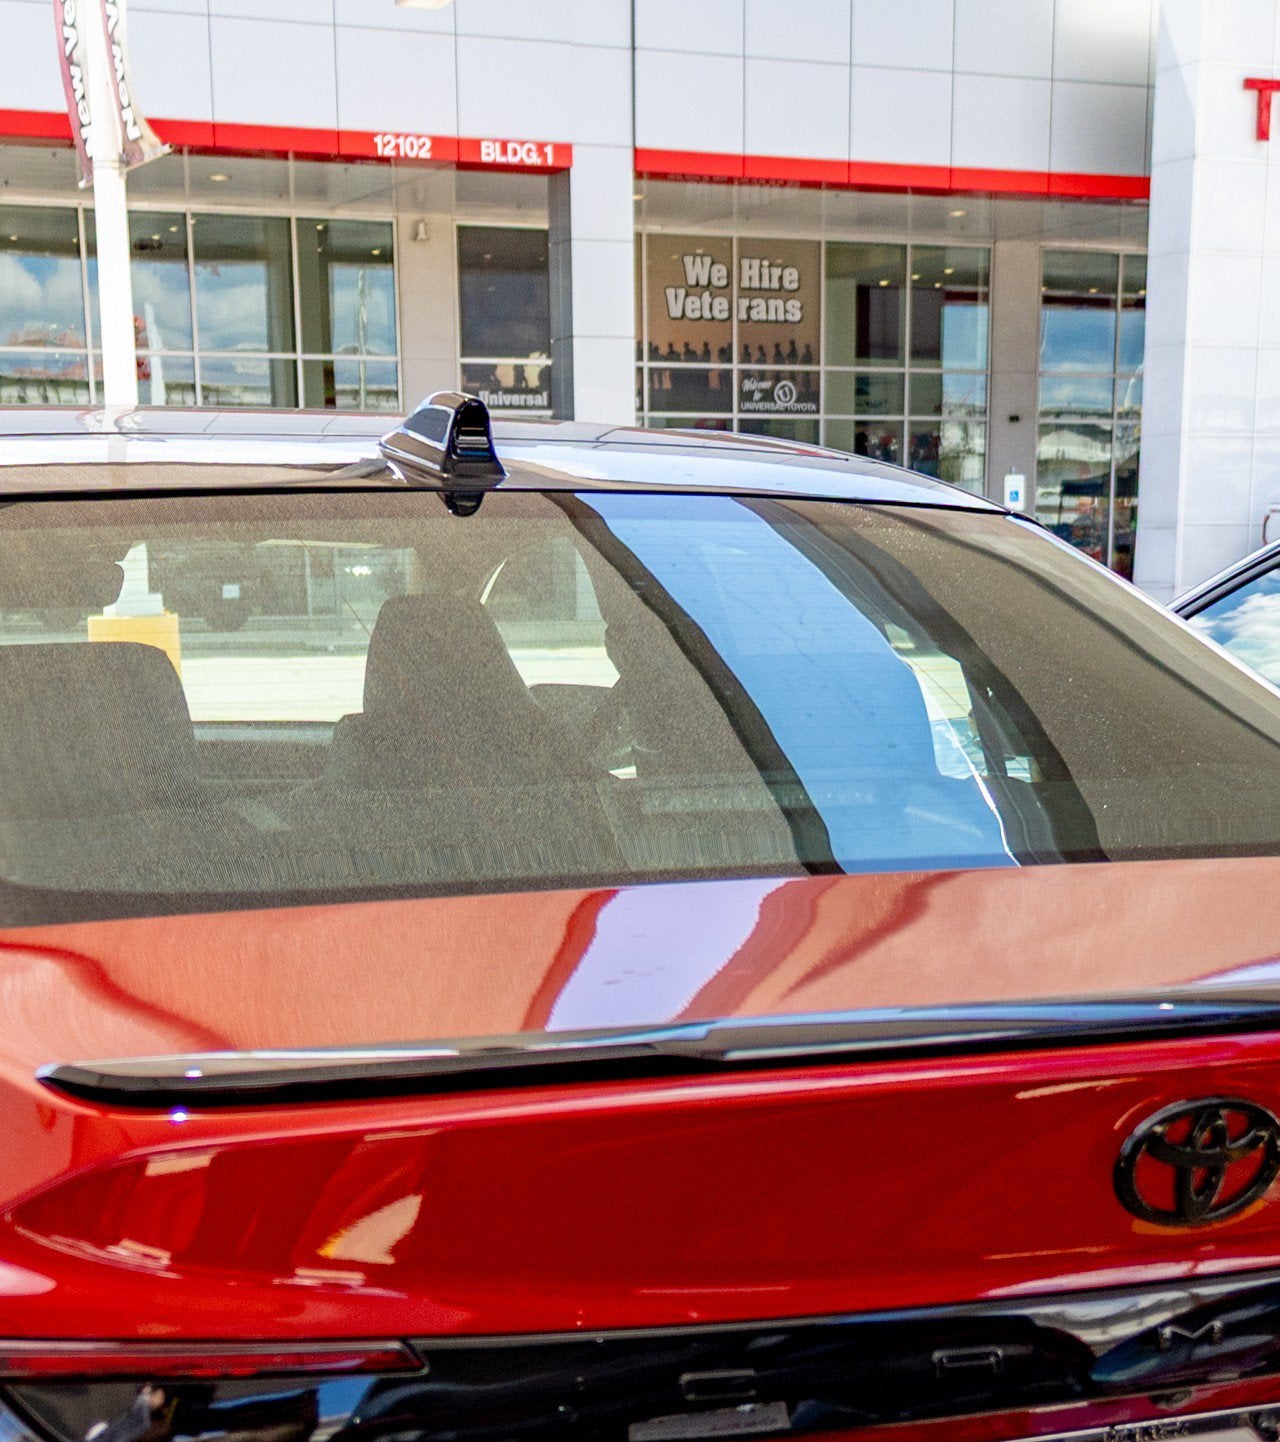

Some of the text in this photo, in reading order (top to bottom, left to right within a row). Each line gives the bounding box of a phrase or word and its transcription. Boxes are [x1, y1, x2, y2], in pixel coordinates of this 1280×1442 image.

[63, 0, 78, 57] Ve
[111, 44, 141, 140] New
[373, 133, 432, 159] 12102
[682, 254, 800, 290] We Hire
[665, 288, 802, 322] Veterans
[478, 390, 548, 407] Universal
